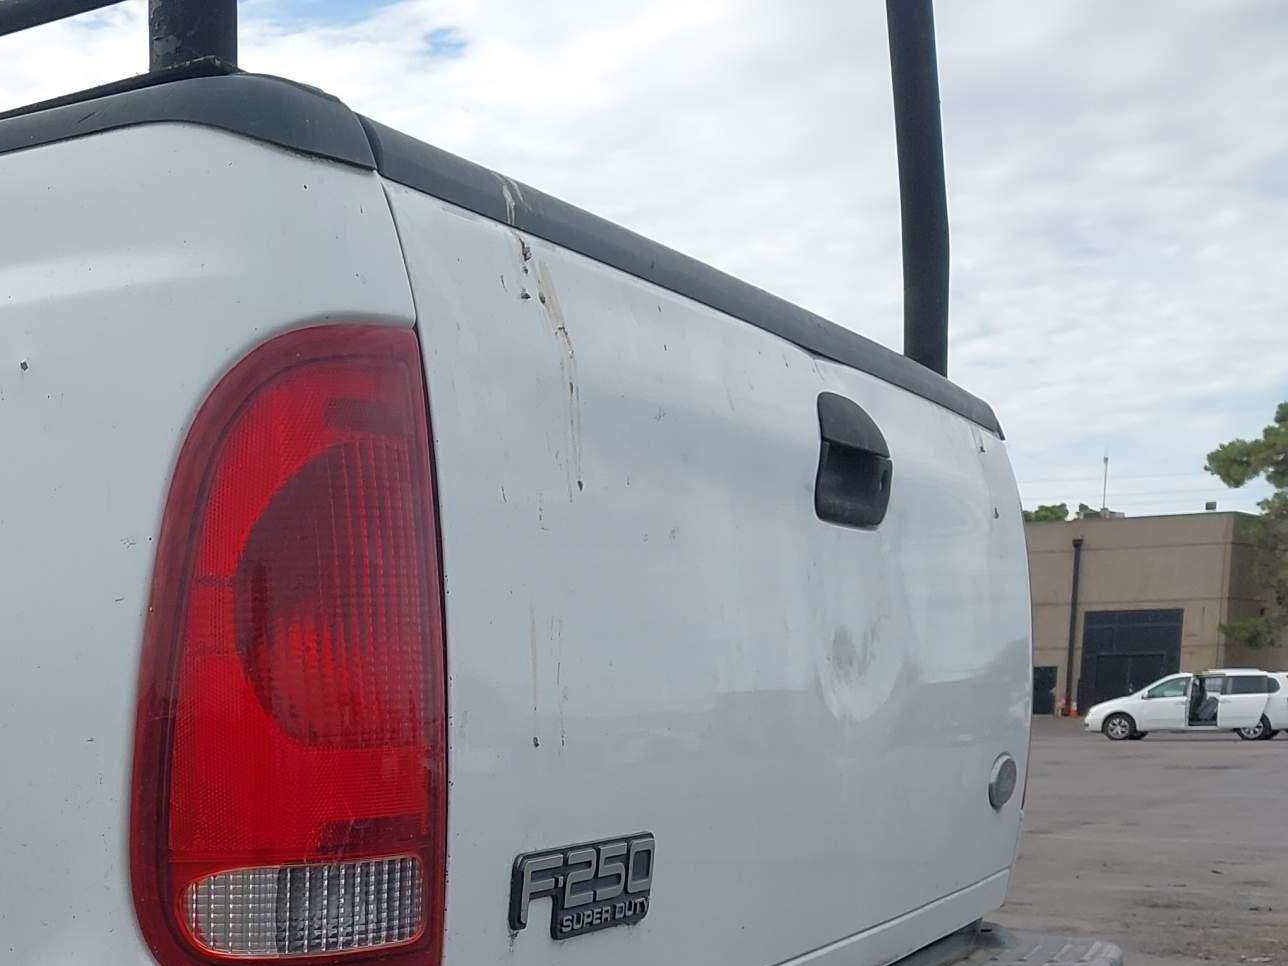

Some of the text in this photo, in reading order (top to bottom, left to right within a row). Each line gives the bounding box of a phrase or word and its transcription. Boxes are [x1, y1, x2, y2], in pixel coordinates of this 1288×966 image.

[519, 837, 656, 925] F-250
[562, 896, 650, 933] SUPER DUTY
